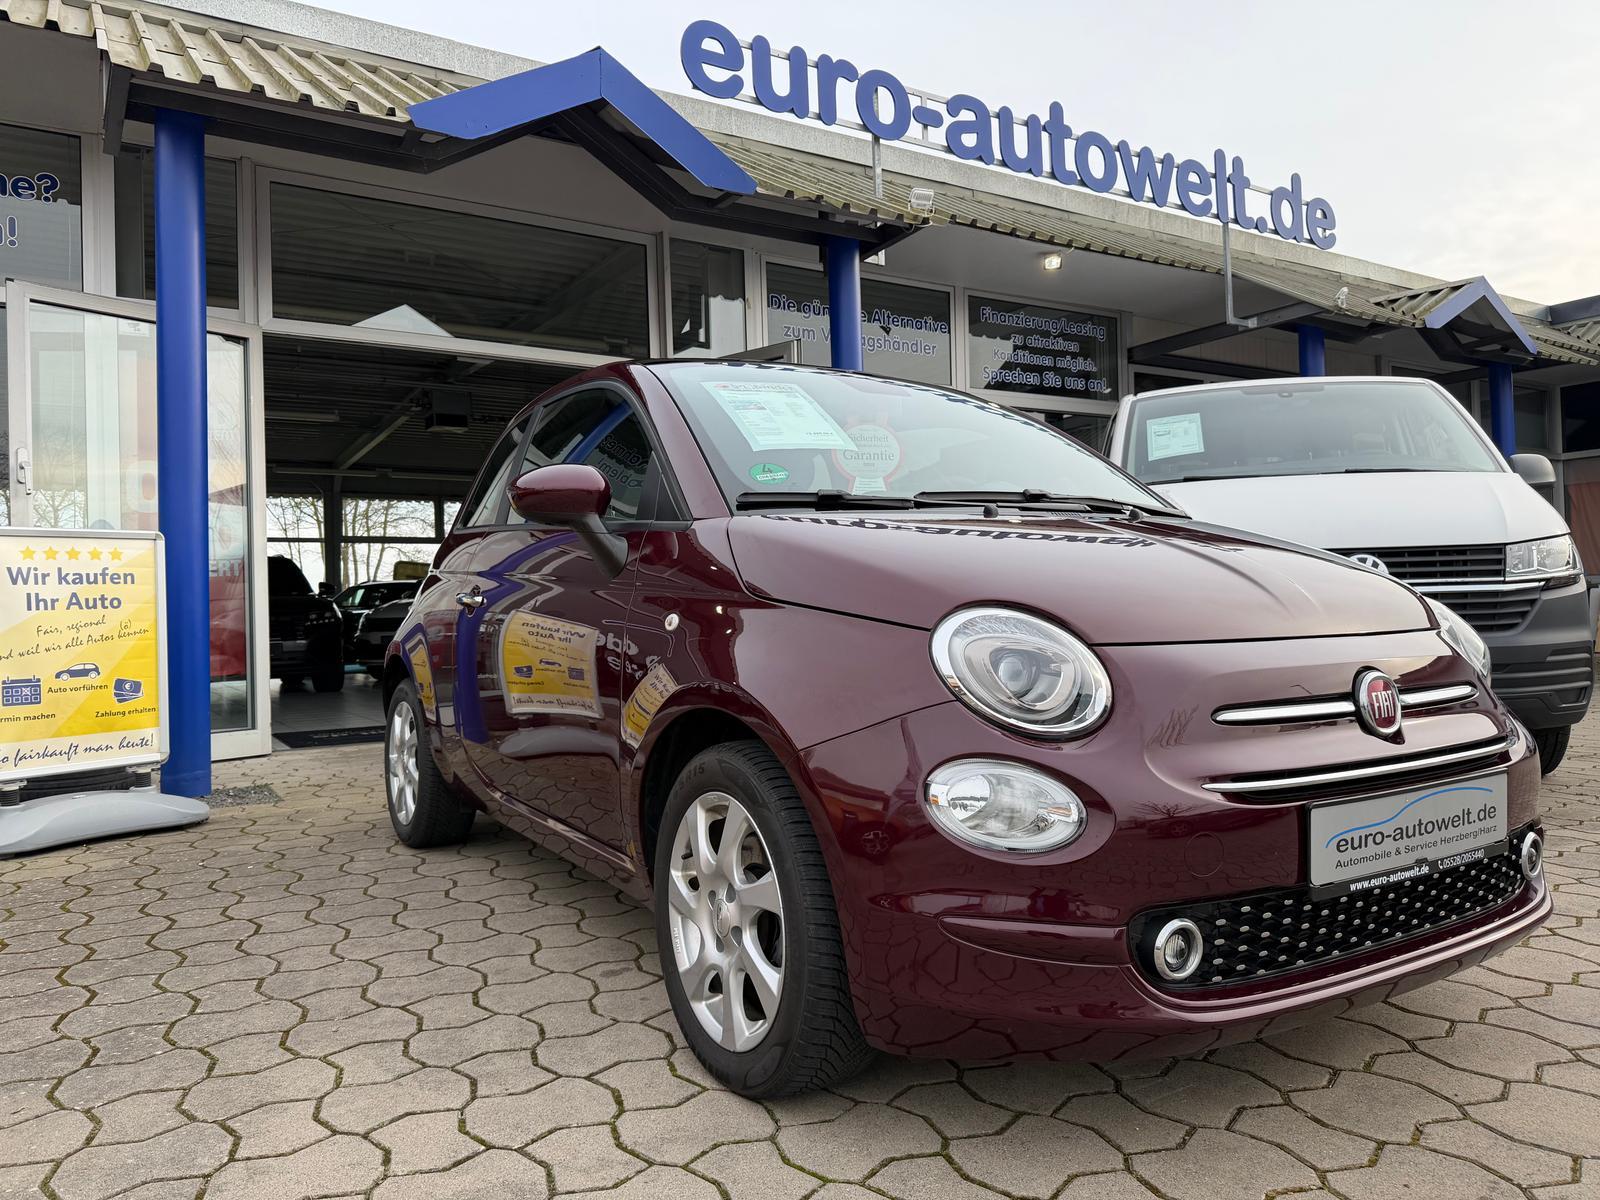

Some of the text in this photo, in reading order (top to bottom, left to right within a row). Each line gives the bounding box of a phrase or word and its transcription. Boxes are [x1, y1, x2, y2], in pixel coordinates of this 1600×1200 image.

[680, 20, 1337, 250] euro-autowelt.de
[769, 293, 797, 311] Die
[872, 308, 950, 334] Alternative
[980, 306, 1106, 342] Finanzierung/Leasing
[783, 325, 816, 342] zum
[1011, 334, 1080, 353] zu attraktiven
[992, 348, 1098, 373] Konditionen möglich.
[983, 366, 1108, 393] Sprechen Sie uns an!
[843, 448, 895, 461] Garantie
[6, 566, 136, 586] Wir kaufen
[26, 592, 122, 611] Ihr Auto
[36, 614, 106, 637] Fair, regional
[18, 643, 40, 657] weil
[44, 642, 62, 653] wir
[65, 636, 84, 650] alle
[87, 634, 115, 646] Autos
[47, 683, 109, 694] Auto vorführen
[95, 706, 156, 719] Zahlung erhalten
[1371, 690, 1395, 719] FIAT
[24, 712, 56, 721] machen
[83, 743, 114, 754] man
[118, 733, 154, 750] heute!
[1335, 803, 1497, 853] euro-autowelt.de
[1335, 824, 1498, 870] Automobile & Service Herzberg/Harz
[1349, 864, 1430, 892] www.euro-autowelt.de
